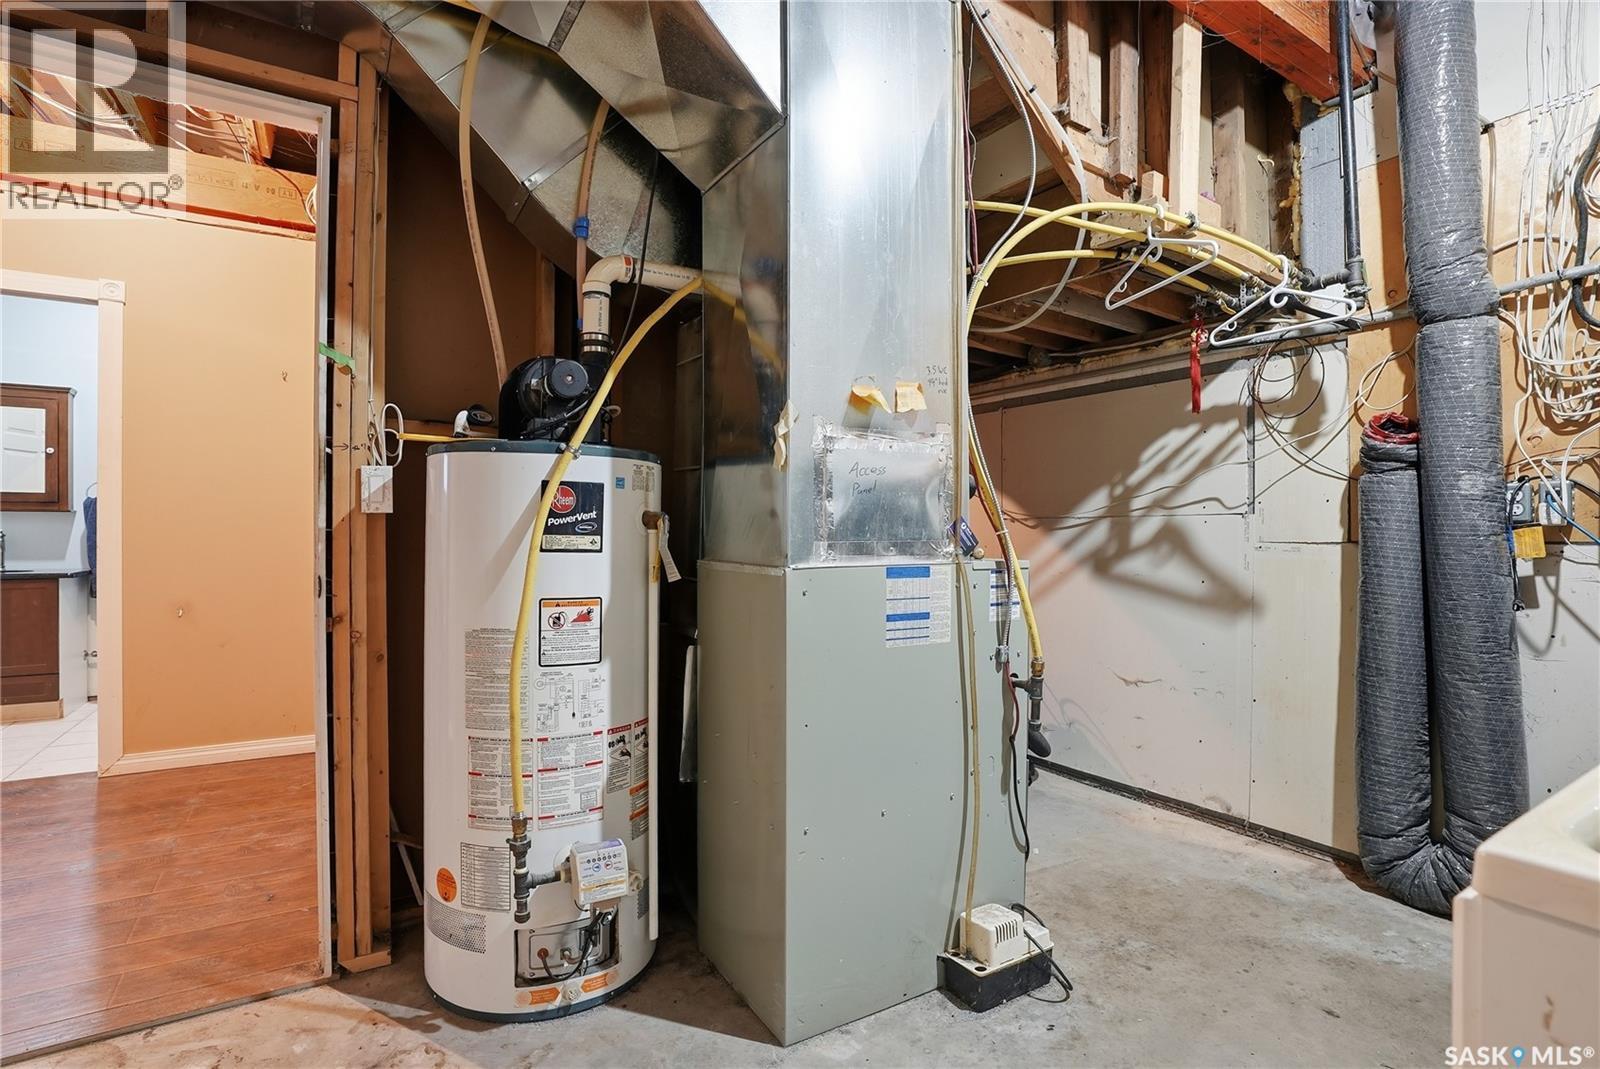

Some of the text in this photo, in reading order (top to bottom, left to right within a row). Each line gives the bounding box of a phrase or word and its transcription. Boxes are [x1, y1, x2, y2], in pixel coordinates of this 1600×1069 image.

[848, 461, 886, 479] Access
[851, 480, 877, 497] Panel
[548, 510, 597, 526] PowerVent
